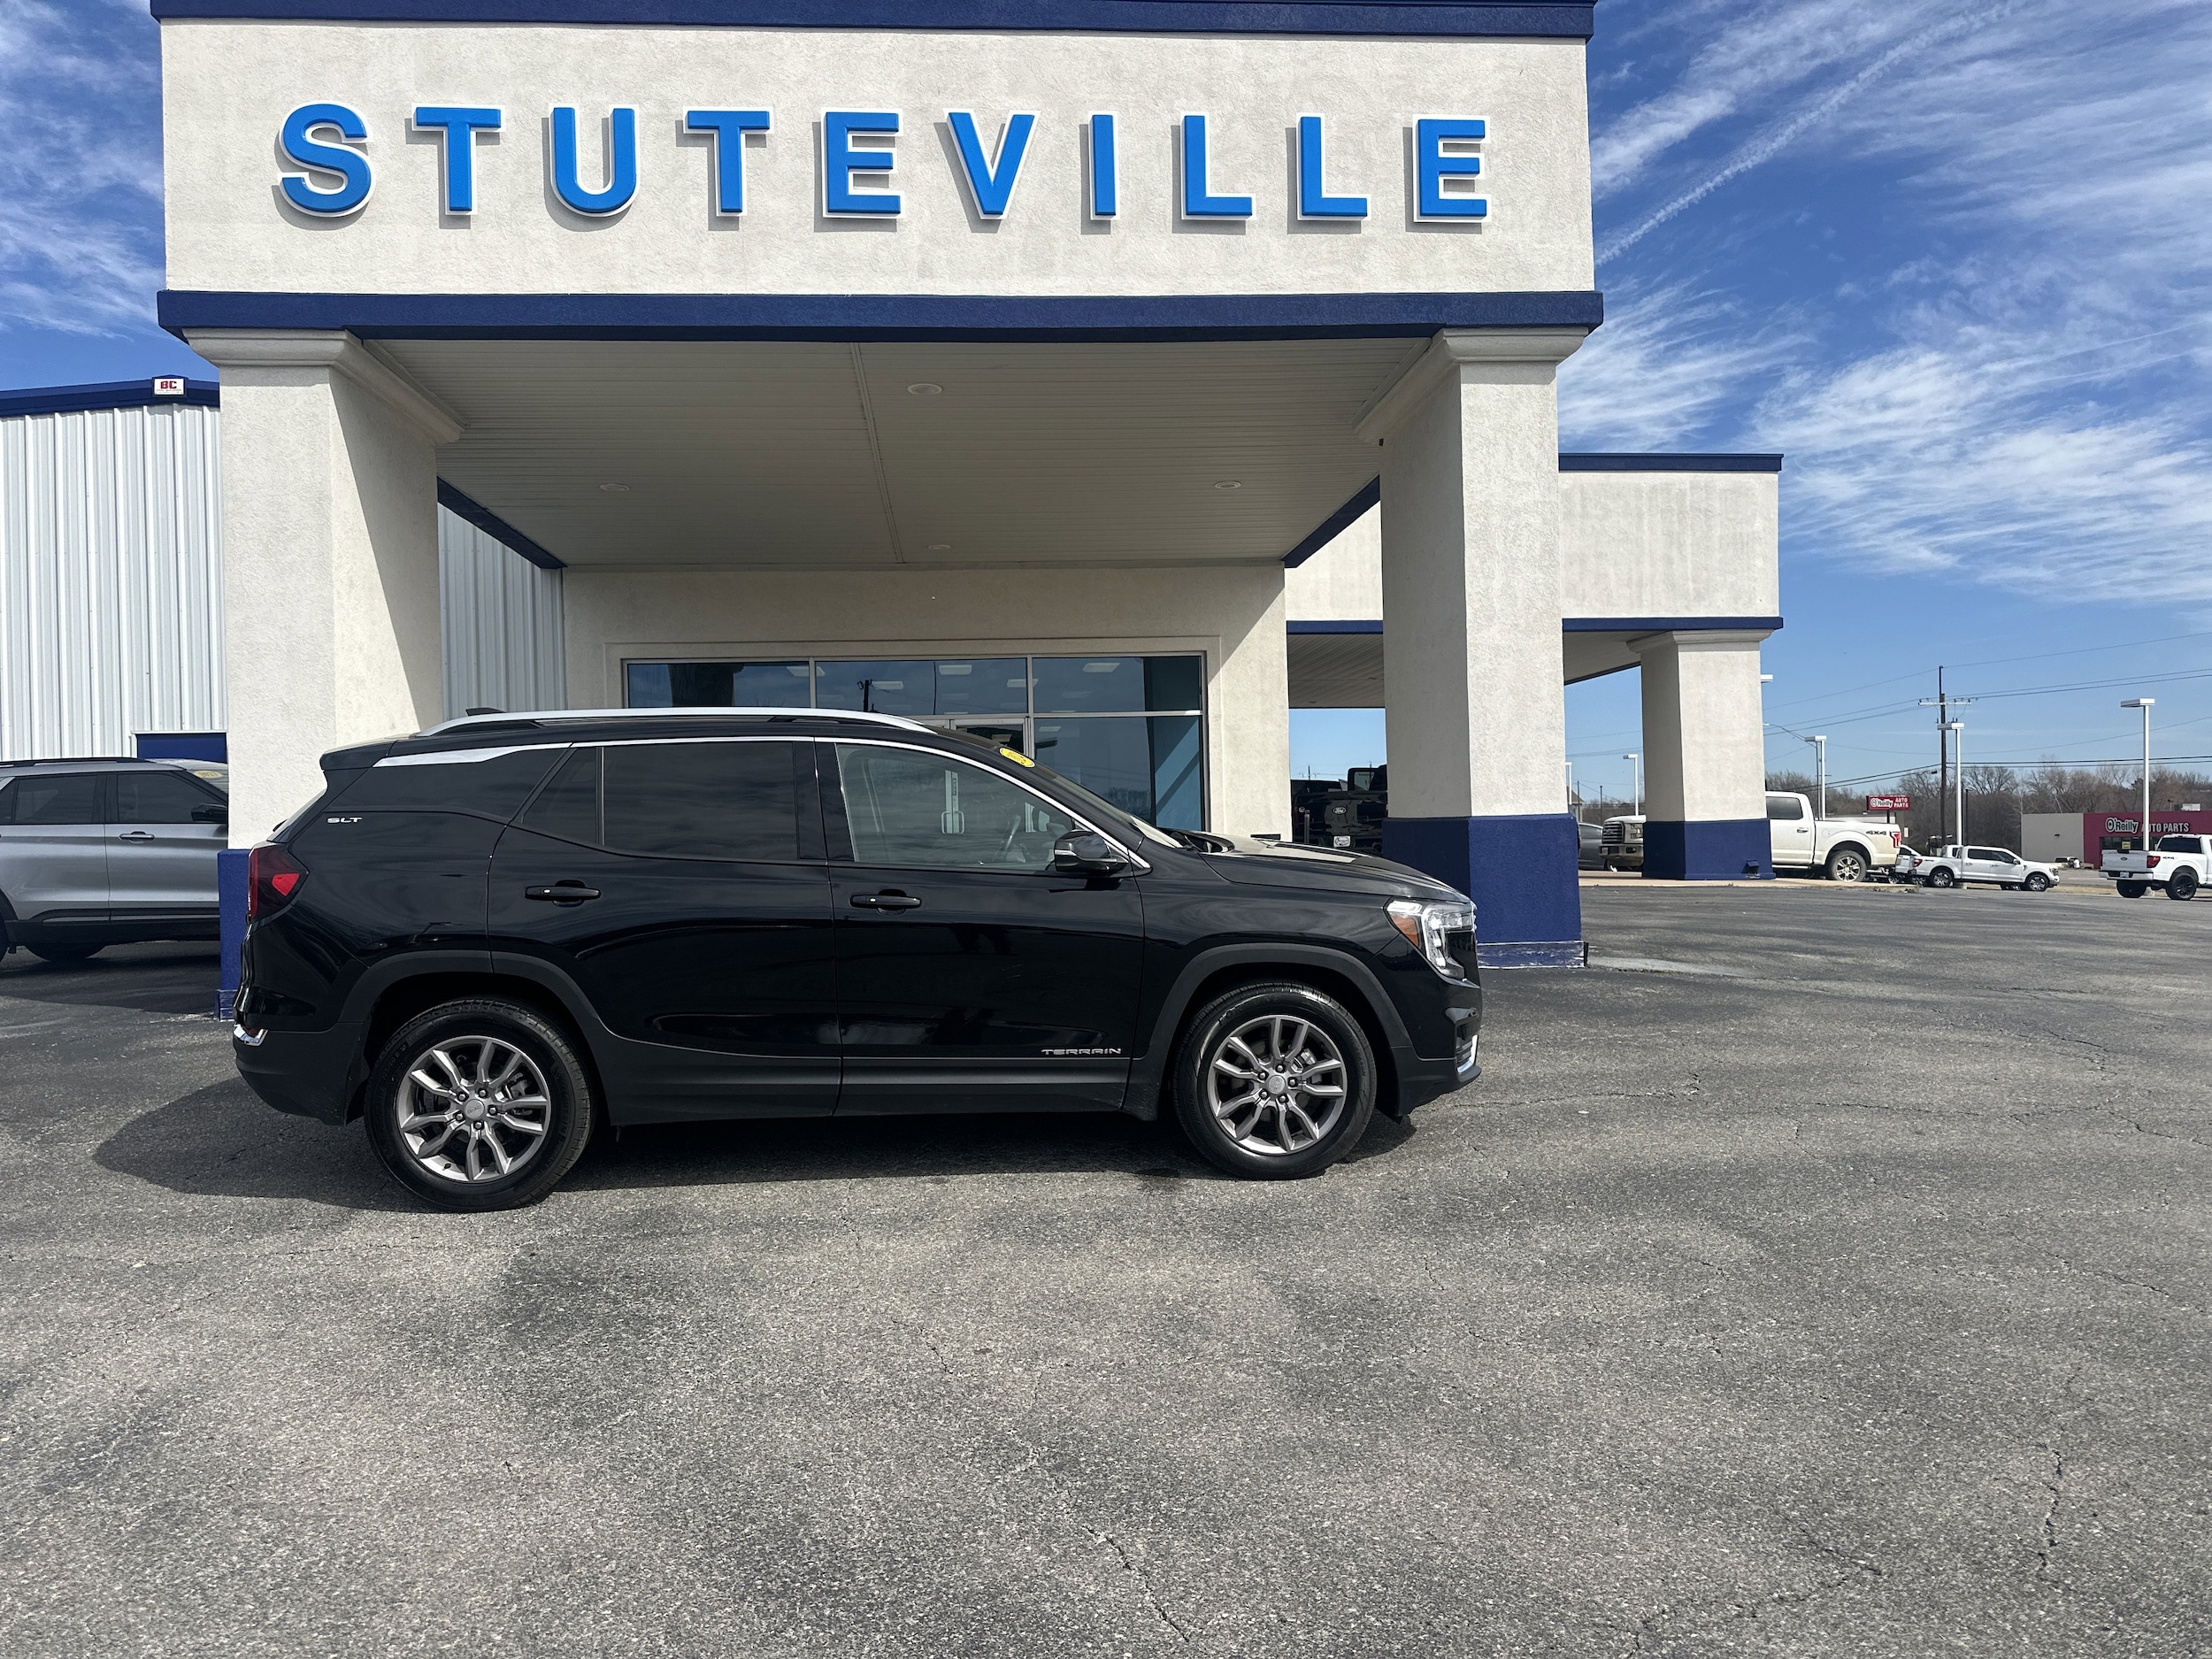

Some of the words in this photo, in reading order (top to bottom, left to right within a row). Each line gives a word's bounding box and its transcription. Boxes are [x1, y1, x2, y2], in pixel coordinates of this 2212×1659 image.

[281, 103, 1487, 218] STUTEVILLE
[160, 380, 177, 389] BC
[1870, 798, 1893, 808] O'Reilly
[2106, 818, 2139, 833] O'Reilly
[2141, 823, 2162, 832] TO
[2162, 823, 2189, 832] PARTS
